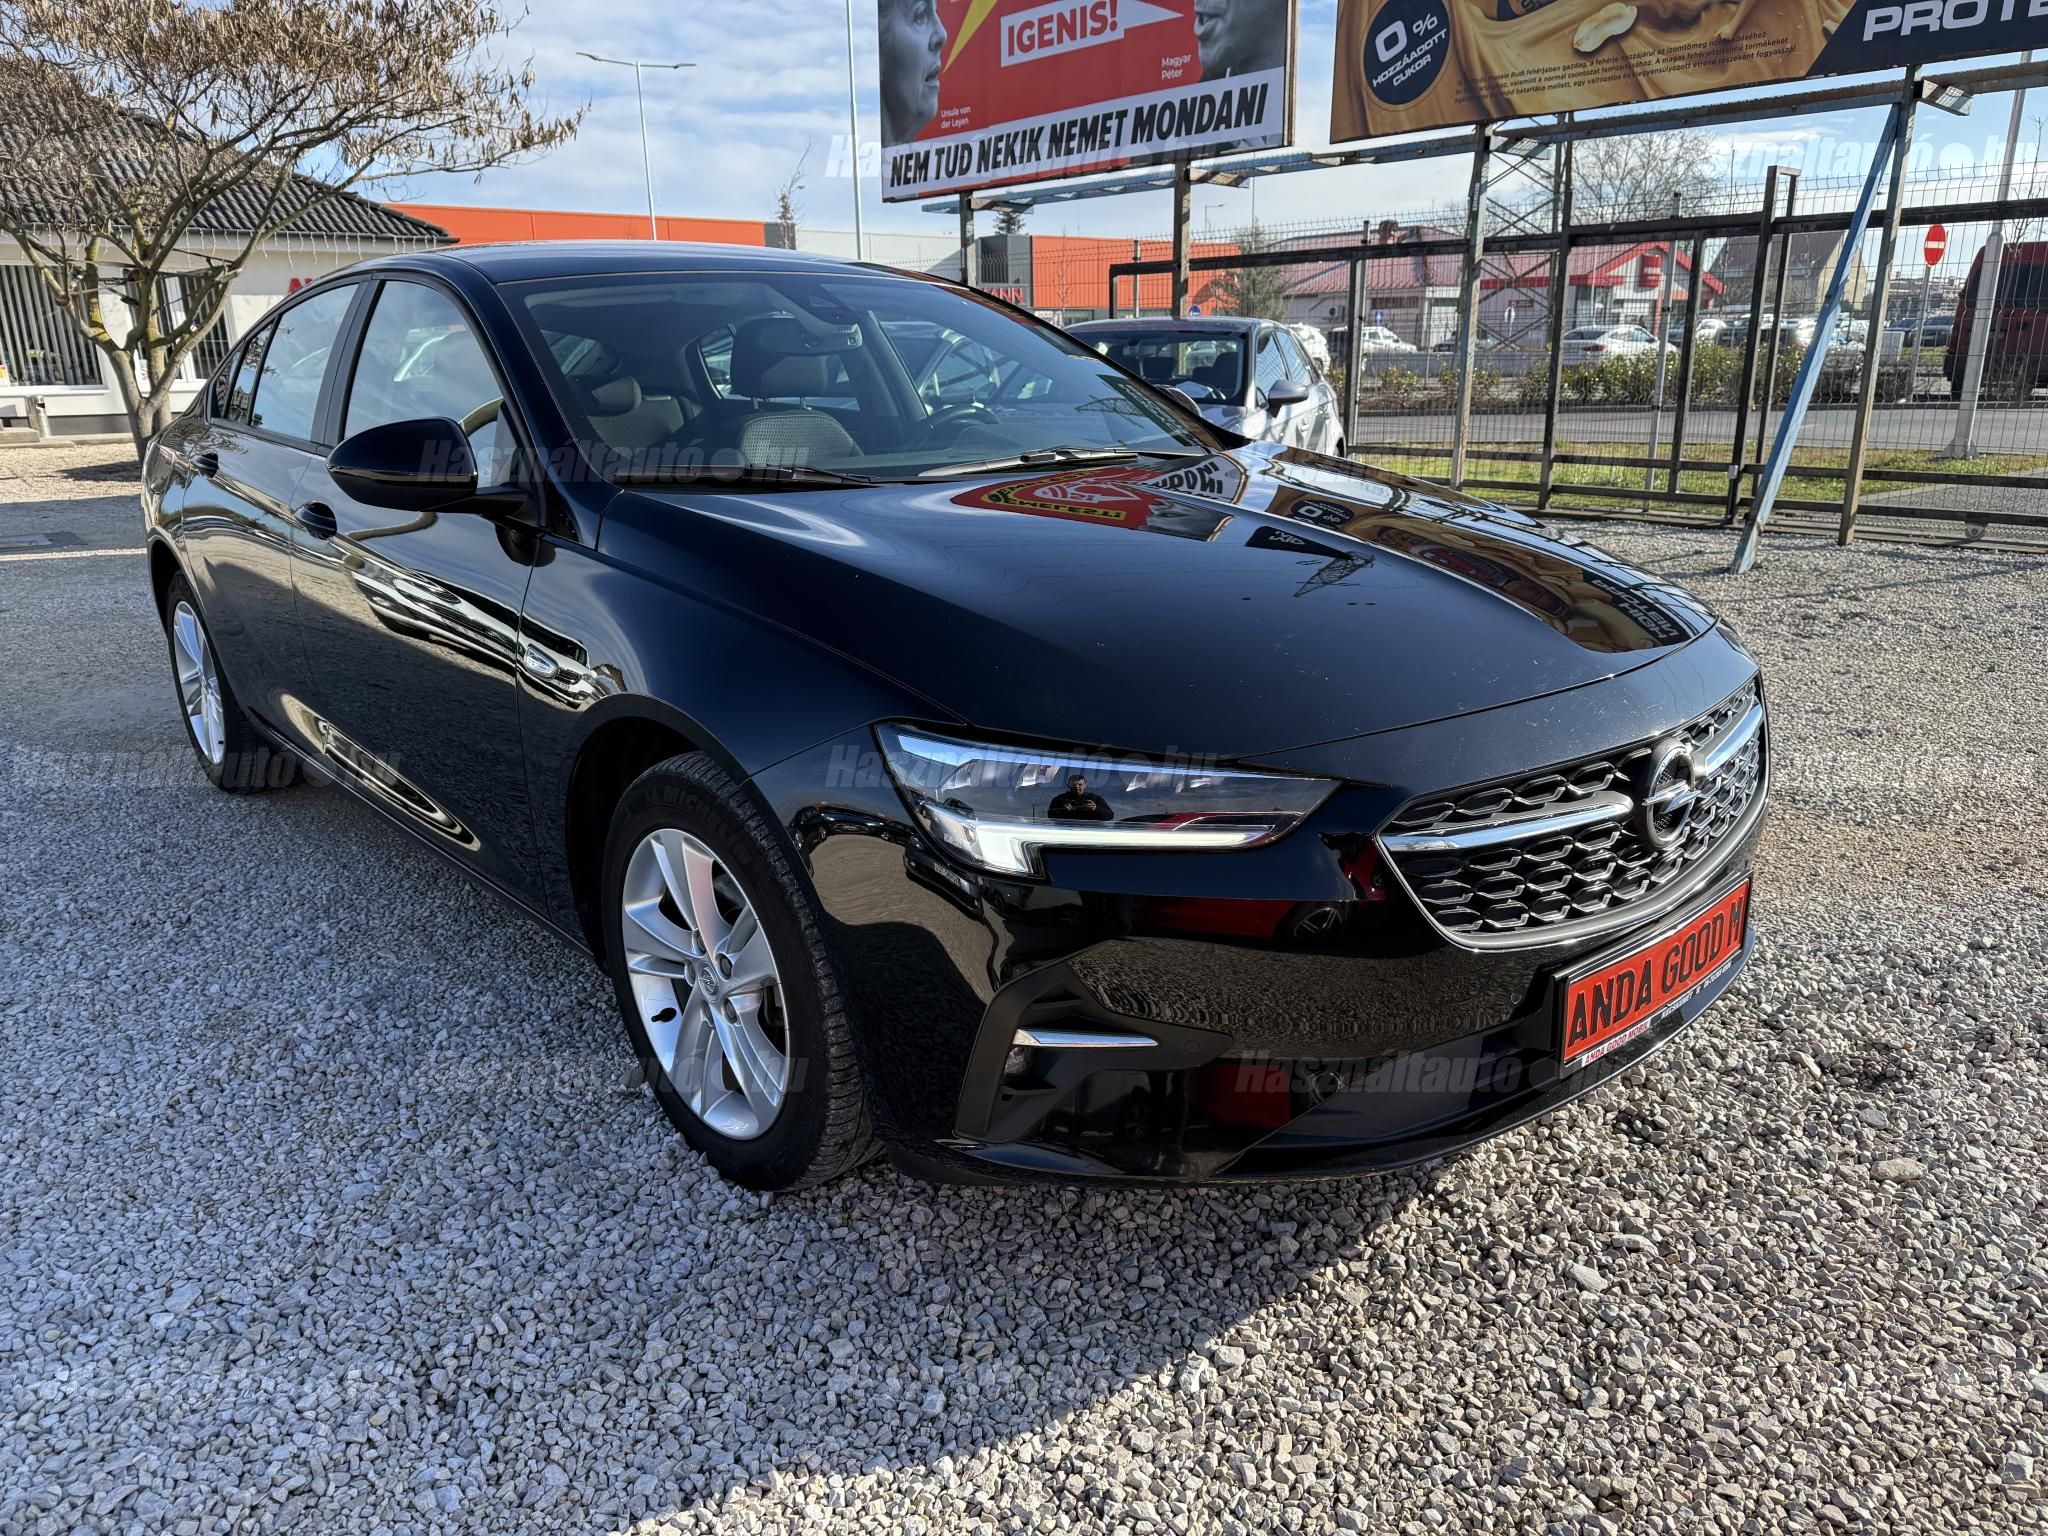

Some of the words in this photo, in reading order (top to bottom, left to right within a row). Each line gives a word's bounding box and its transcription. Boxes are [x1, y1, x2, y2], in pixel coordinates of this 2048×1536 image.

[1007, 0, 1119, 57] IGENIS!
[1161, 53, 1192, 68] Magyar
[1372, 28, 1448, 88] HOZZÁADOTT
[1392, 54, 1432, 87] CUKOR
[1161, 68, 1183, 80] Péter
[940, 108, 960, 118] Ursula
[960, 106, 972, 115] von
[940, 119, 951, 129] der
[951, 117, 970, 128] Leyen
[889, 149, 931, 188] NEM
[934, 142, 973, 181] TUD
[976, 125, 1045, 174] NEKIK
[1046, 109, 1129, 160] NEMET
[1130, 83, 1269, 145] MONDANI
[1567, 959, 1652, 1049] ANDA
[1661, 912, 1723, 994] GOOD
[1728, 897, 1744, 953] M
[1584, 1049, 1606, 1066] ANDA
[1606, 1036, 1628, 1052] GOOD
